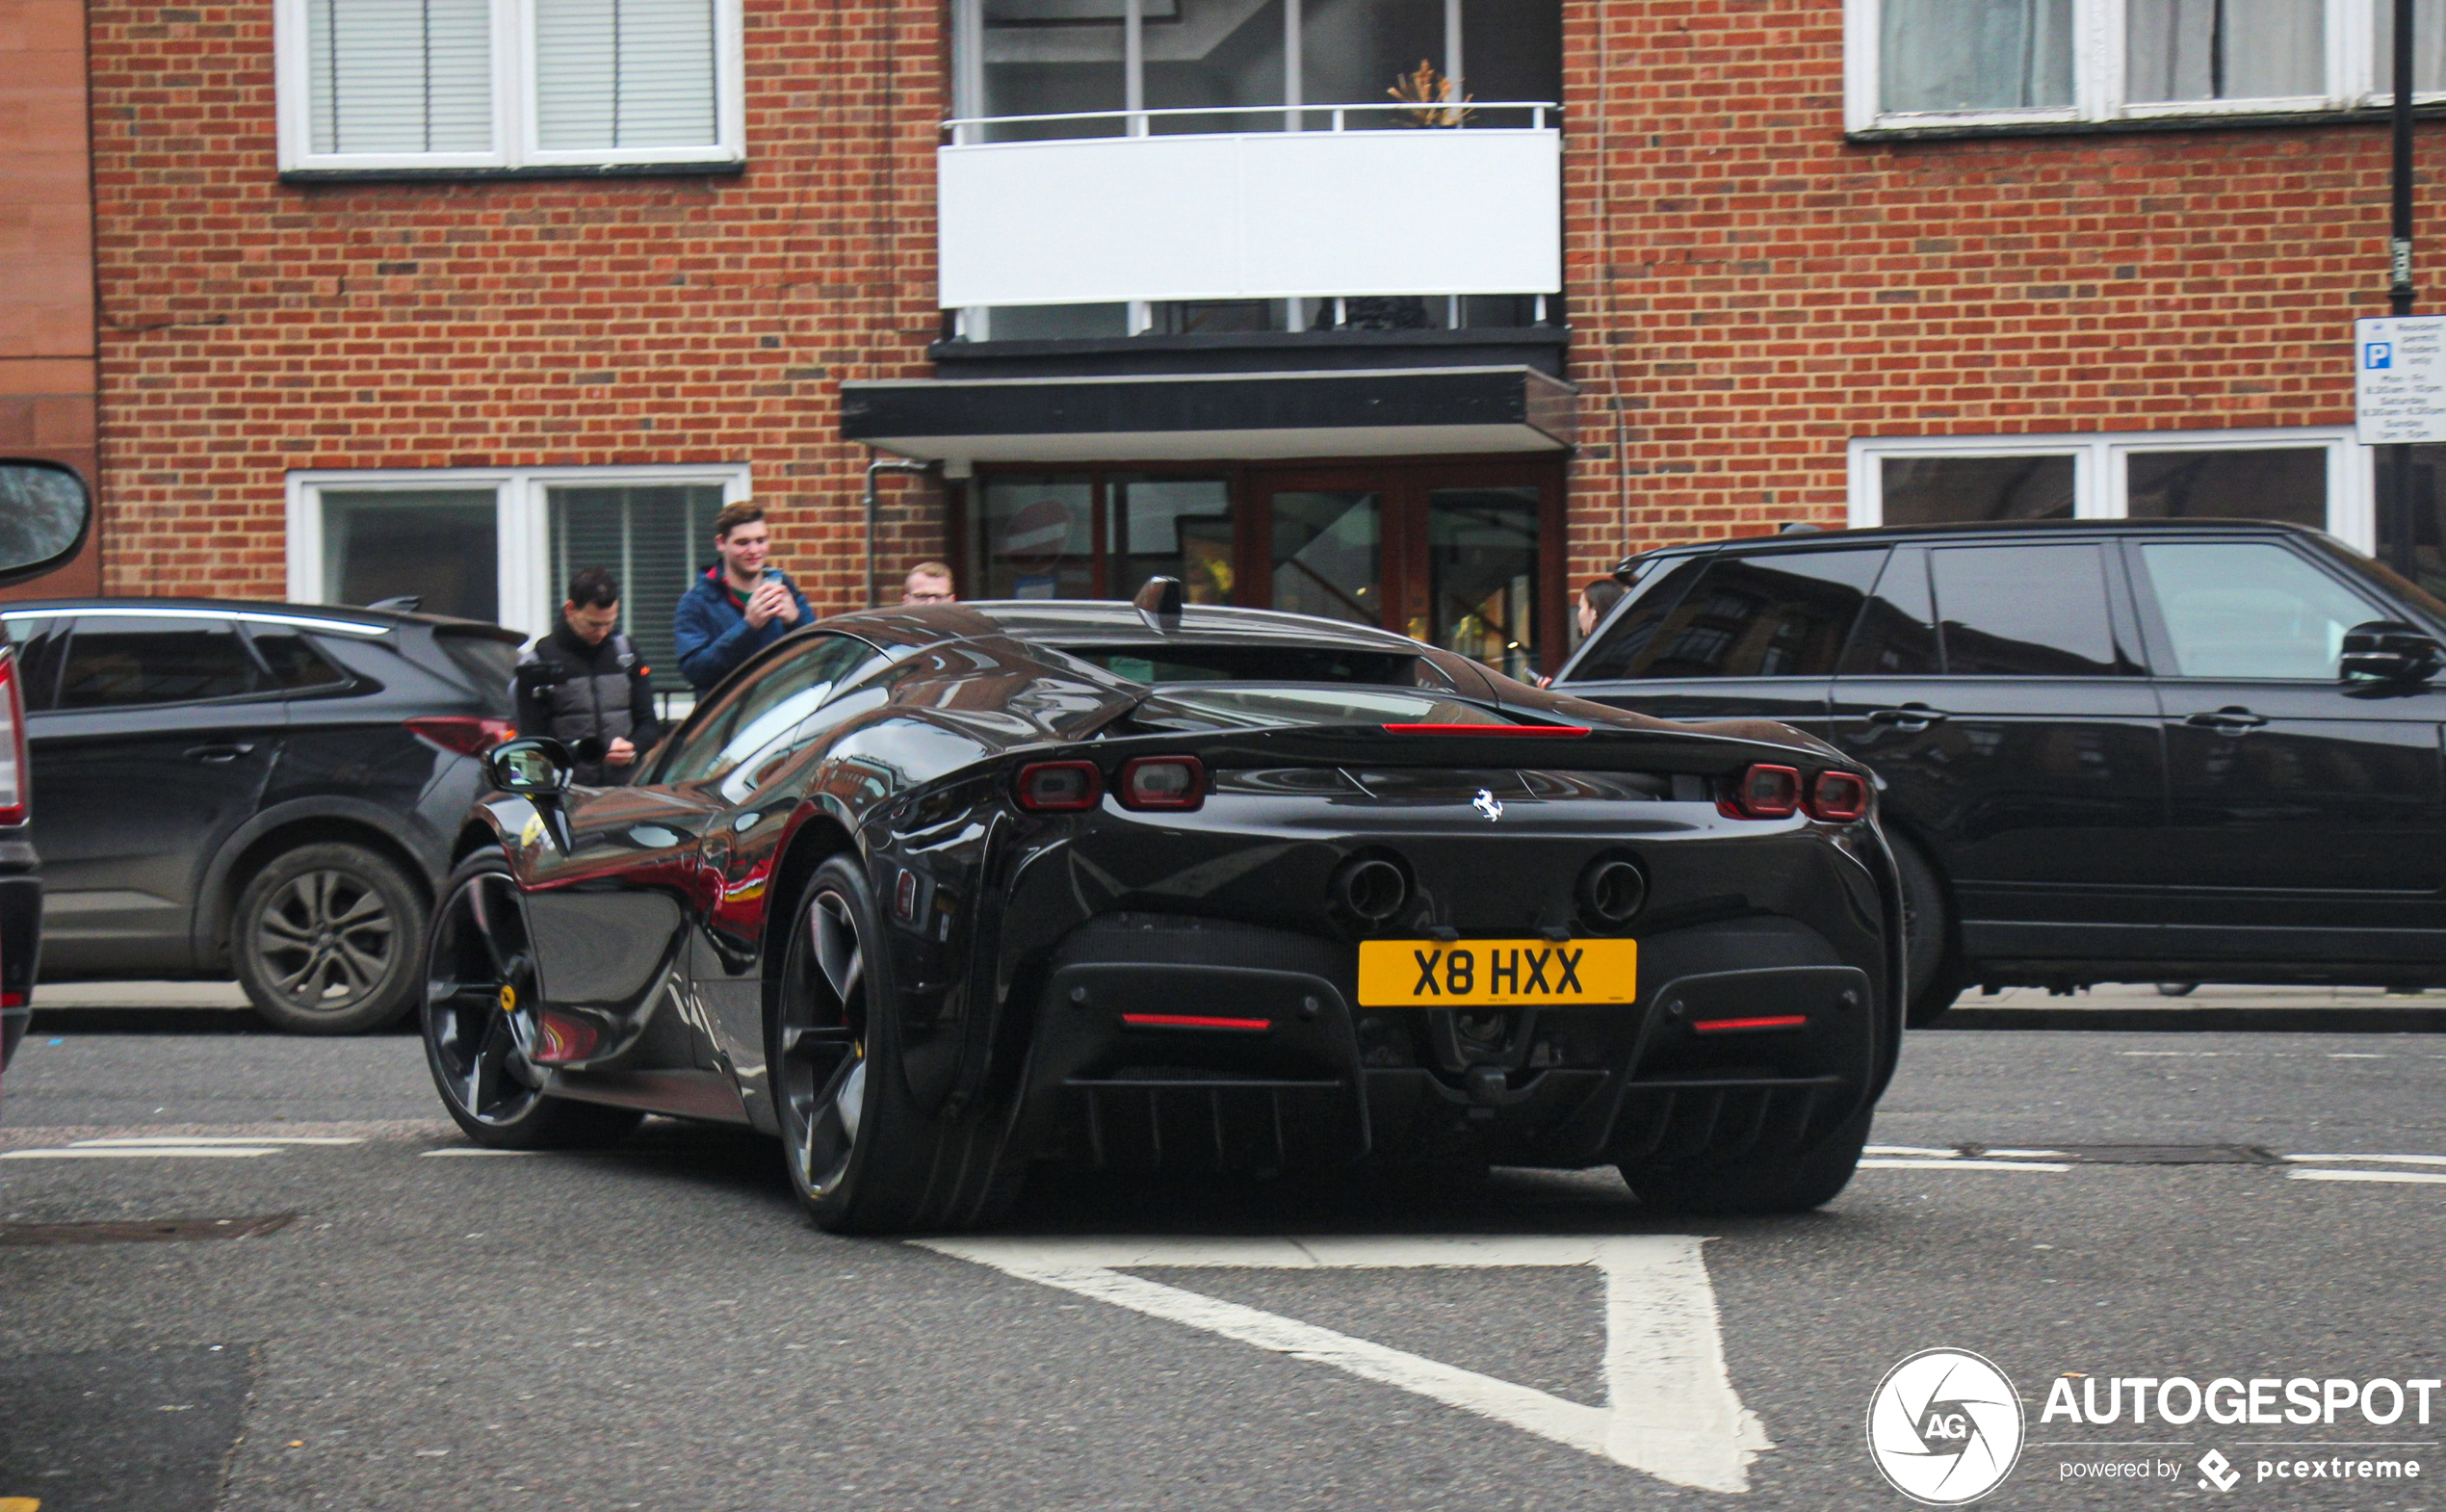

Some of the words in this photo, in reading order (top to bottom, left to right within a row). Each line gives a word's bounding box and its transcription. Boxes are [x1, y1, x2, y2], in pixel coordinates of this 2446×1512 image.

[2369, 344, 2388, 367] P
[1414, 951, 1473, 995] X8
[1492, 949, 1582, 994] HXX
